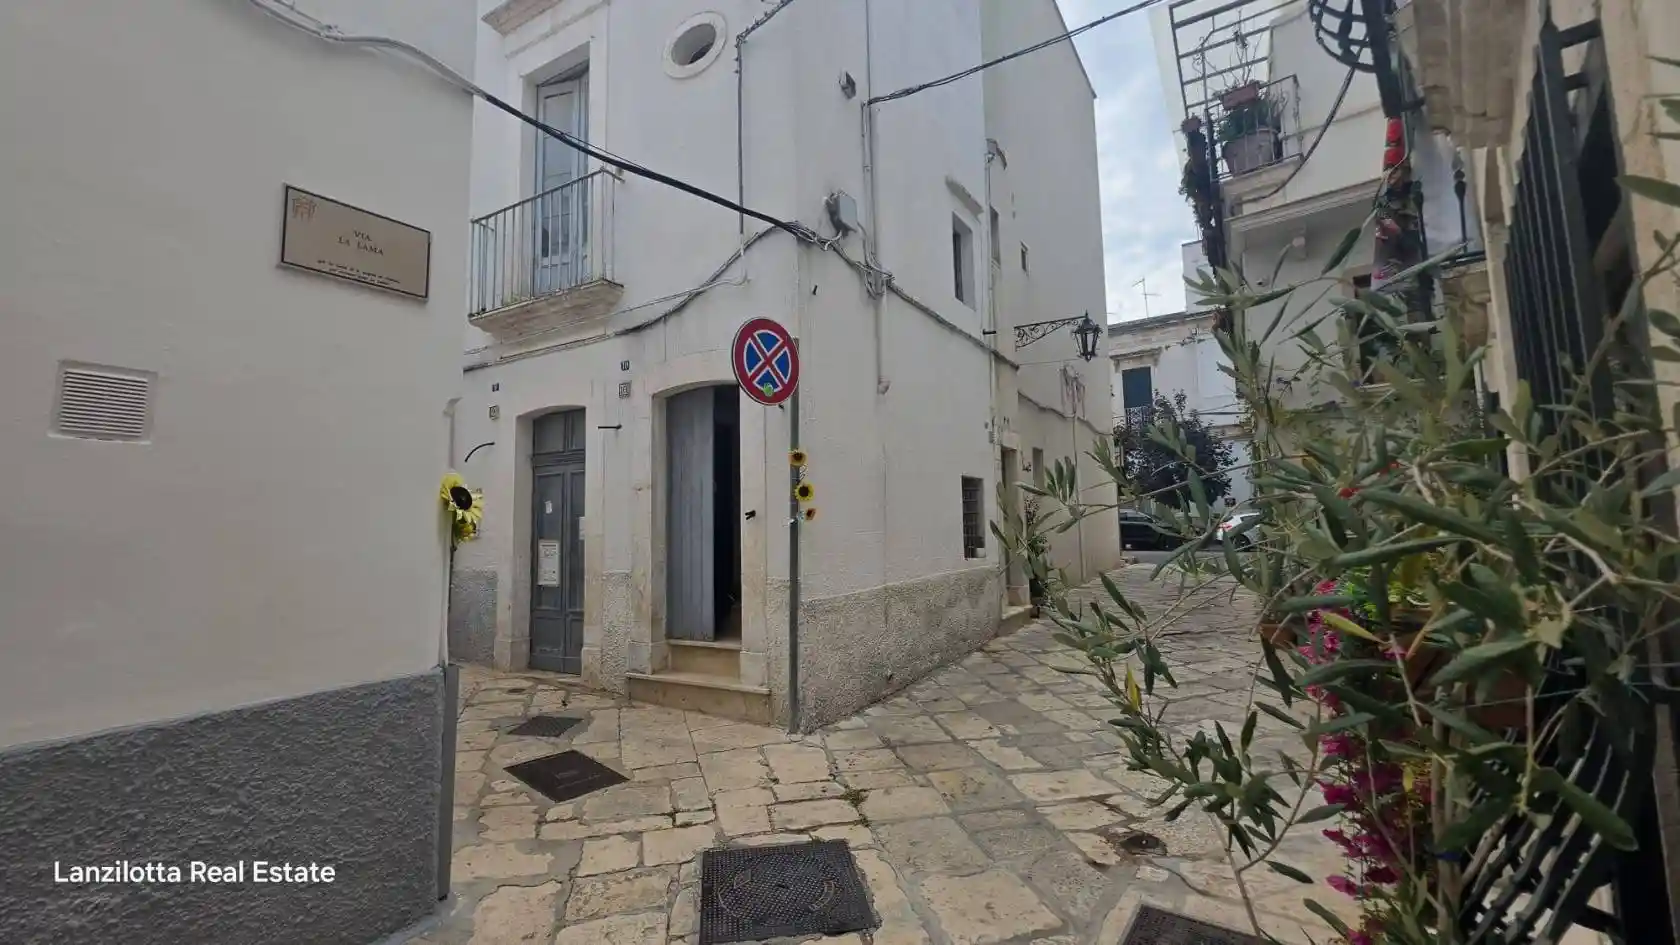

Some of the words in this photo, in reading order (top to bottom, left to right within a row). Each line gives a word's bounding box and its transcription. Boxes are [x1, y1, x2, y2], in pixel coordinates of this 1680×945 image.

[353, 230, 373, 242] VIA
[338, 236, 351, 247] LA
[357, 240, 384, 256] LAMA
